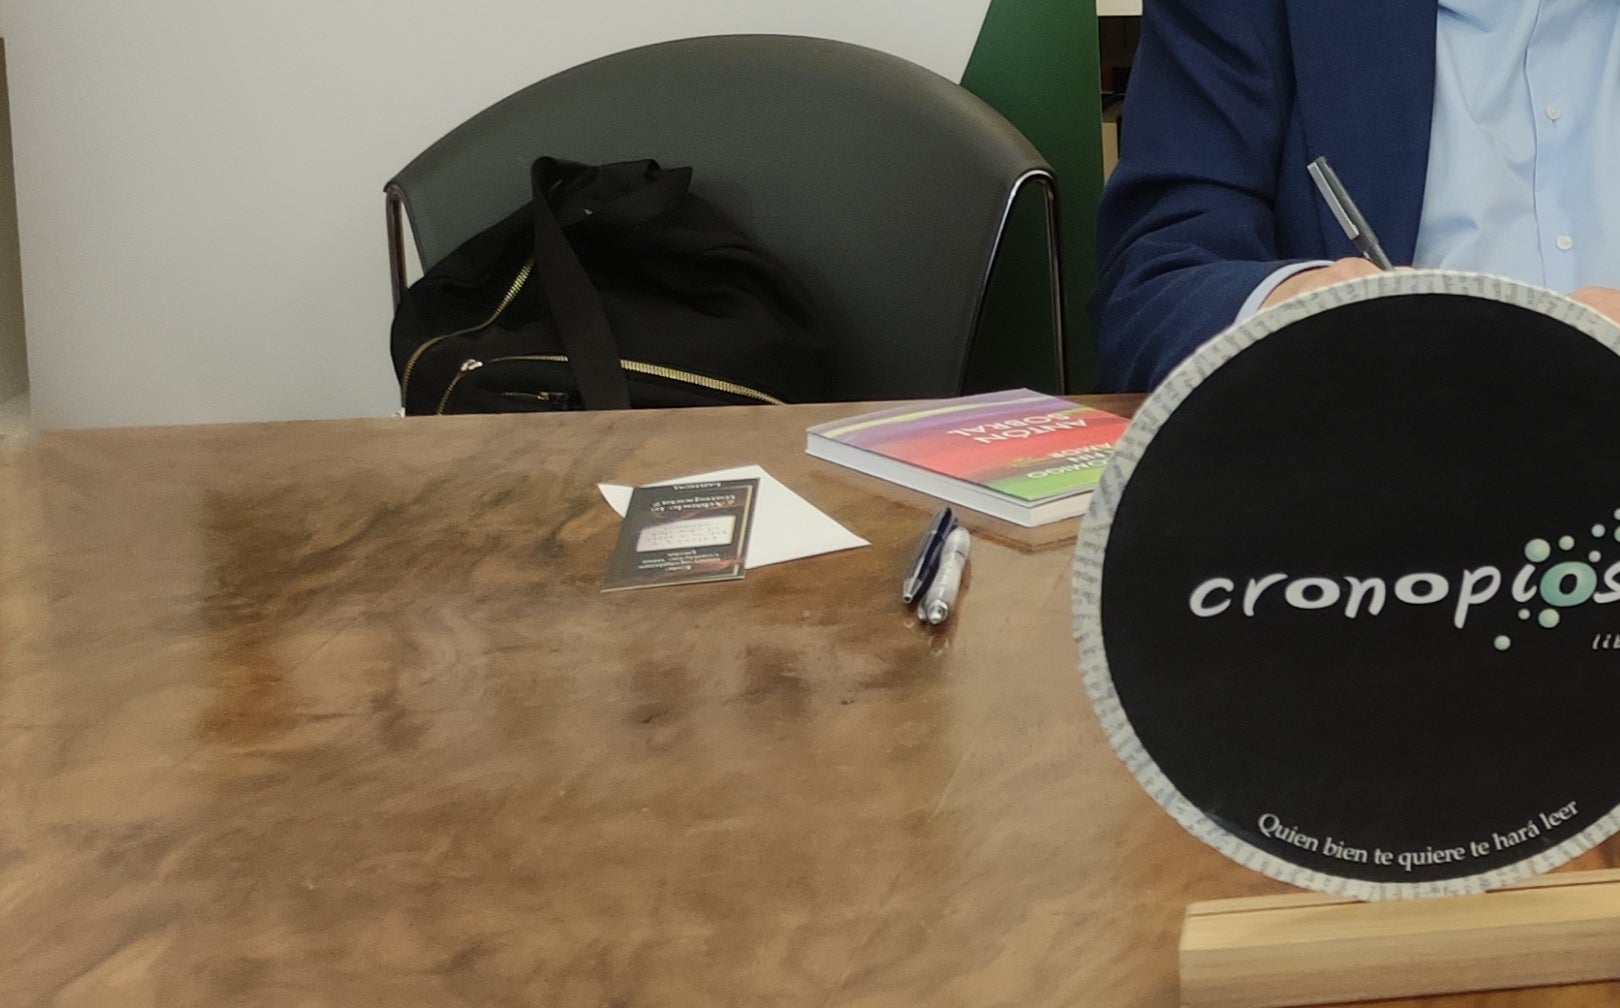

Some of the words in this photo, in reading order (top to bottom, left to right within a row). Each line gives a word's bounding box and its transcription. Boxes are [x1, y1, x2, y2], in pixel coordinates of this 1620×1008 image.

[946, 413, 1071, 437] SOBRAL
[973, 419, 1089, 444] ANTÓN
[1258, 812, 1319, 853] Quien
[1322, 836, 1369, 865] bien
[1373, 848, 1394, 867] te
[1398, 847, 1467, 873] quiere
[1469, 841, 1491, 859] te
[1491, 819, 1541, 852] hará
[1539, 800, 1580, 831] leer
